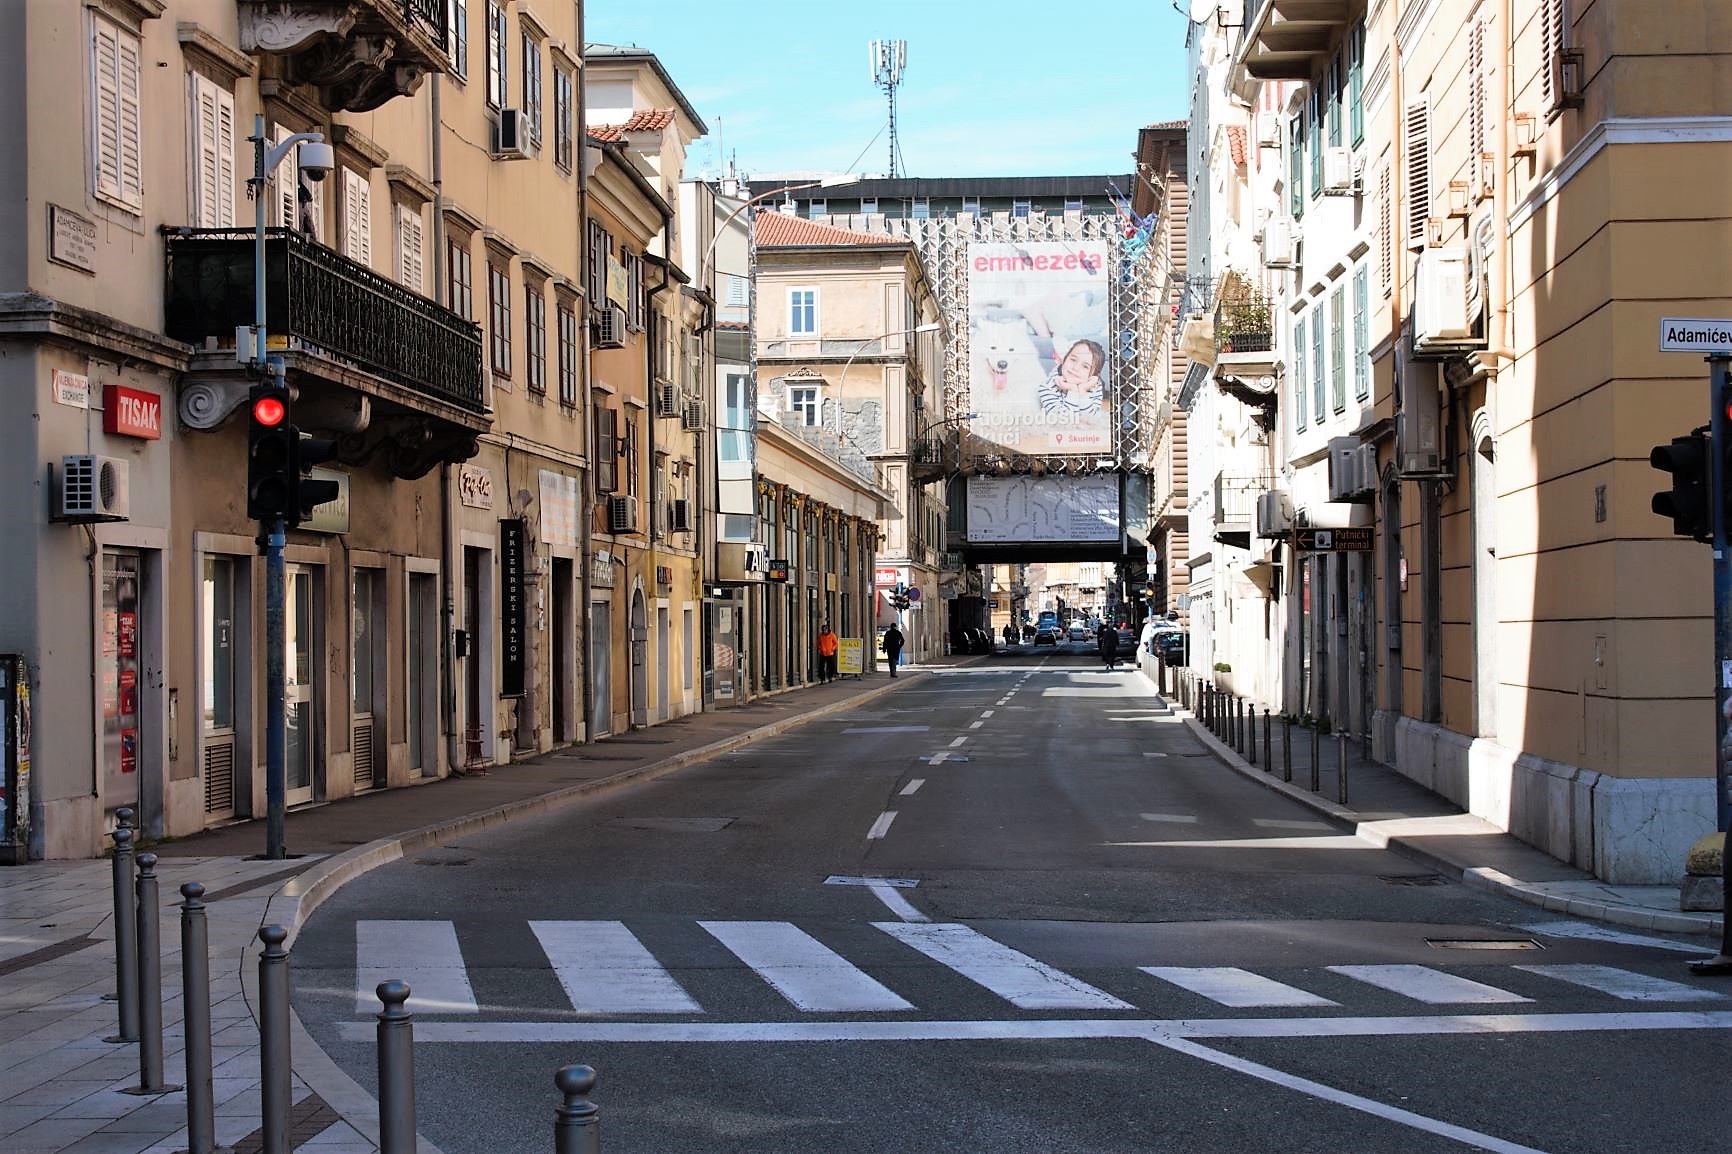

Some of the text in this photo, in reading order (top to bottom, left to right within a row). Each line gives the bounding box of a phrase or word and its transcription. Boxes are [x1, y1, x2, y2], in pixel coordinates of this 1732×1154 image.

[974, 250, 1102, 272] emmezeta
[120, 396, 158, 430] TISAK
[1068, 433, 1100, 444] Škurinje
[1335, 540, 1369, 549] terminal
[509, 530, 517, 611] FRIZERSKI
